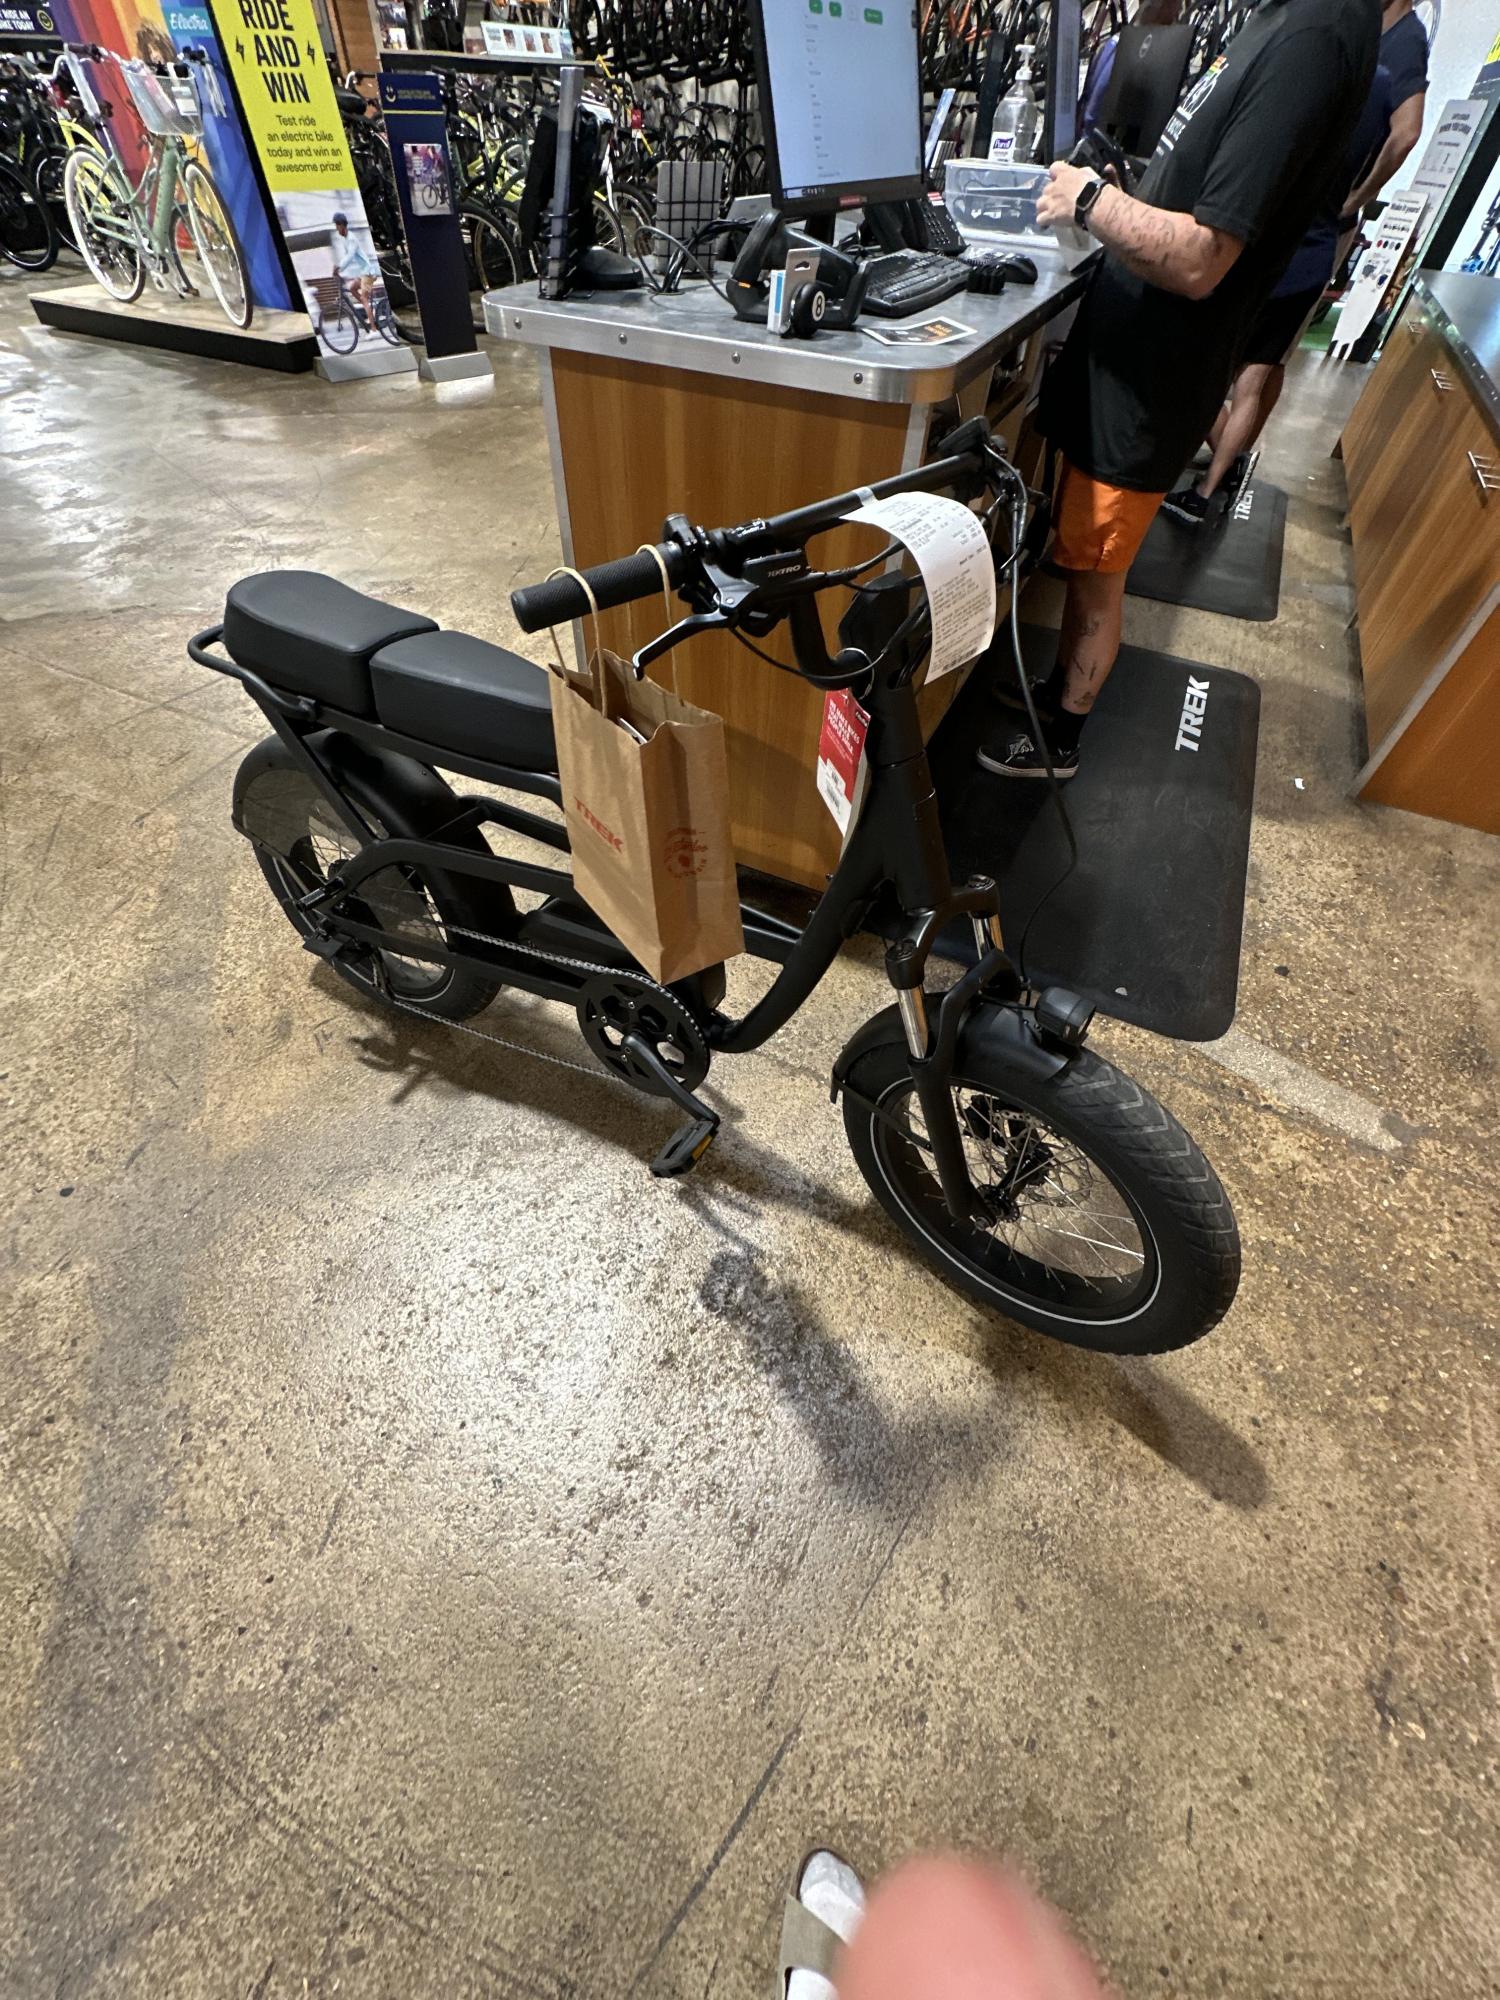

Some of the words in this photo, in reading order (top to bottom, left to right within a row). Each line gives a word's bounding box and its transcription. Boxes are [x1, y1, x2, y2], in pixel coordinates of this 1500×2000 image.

[238, 0, 294, 31] RIDE
[254, 34, 301, 67] AND
[262, 72, 311, 103] WIN
[276, 114, 298, 126] Test
[298, 115, 316, 127] ride
[267, 132, 280, 142] an
[280, 131, 314, 142] electric
[315, 130, 334, 142] bike
[266, 146, 293, 159] today
[294, 145, 313, 157] and
[313, 146, 330, 157] win
[330, 148, 343, 156] an
[275, 162, 318, 173] awesome
[319, 160, 343, 173] prize!
[815, 295, 824, 318] 8
[767, 564, 801, 578] TEKTRO
[1174, 674, 1210, 752] TREK
[573, 796, 625, 854] TREK
